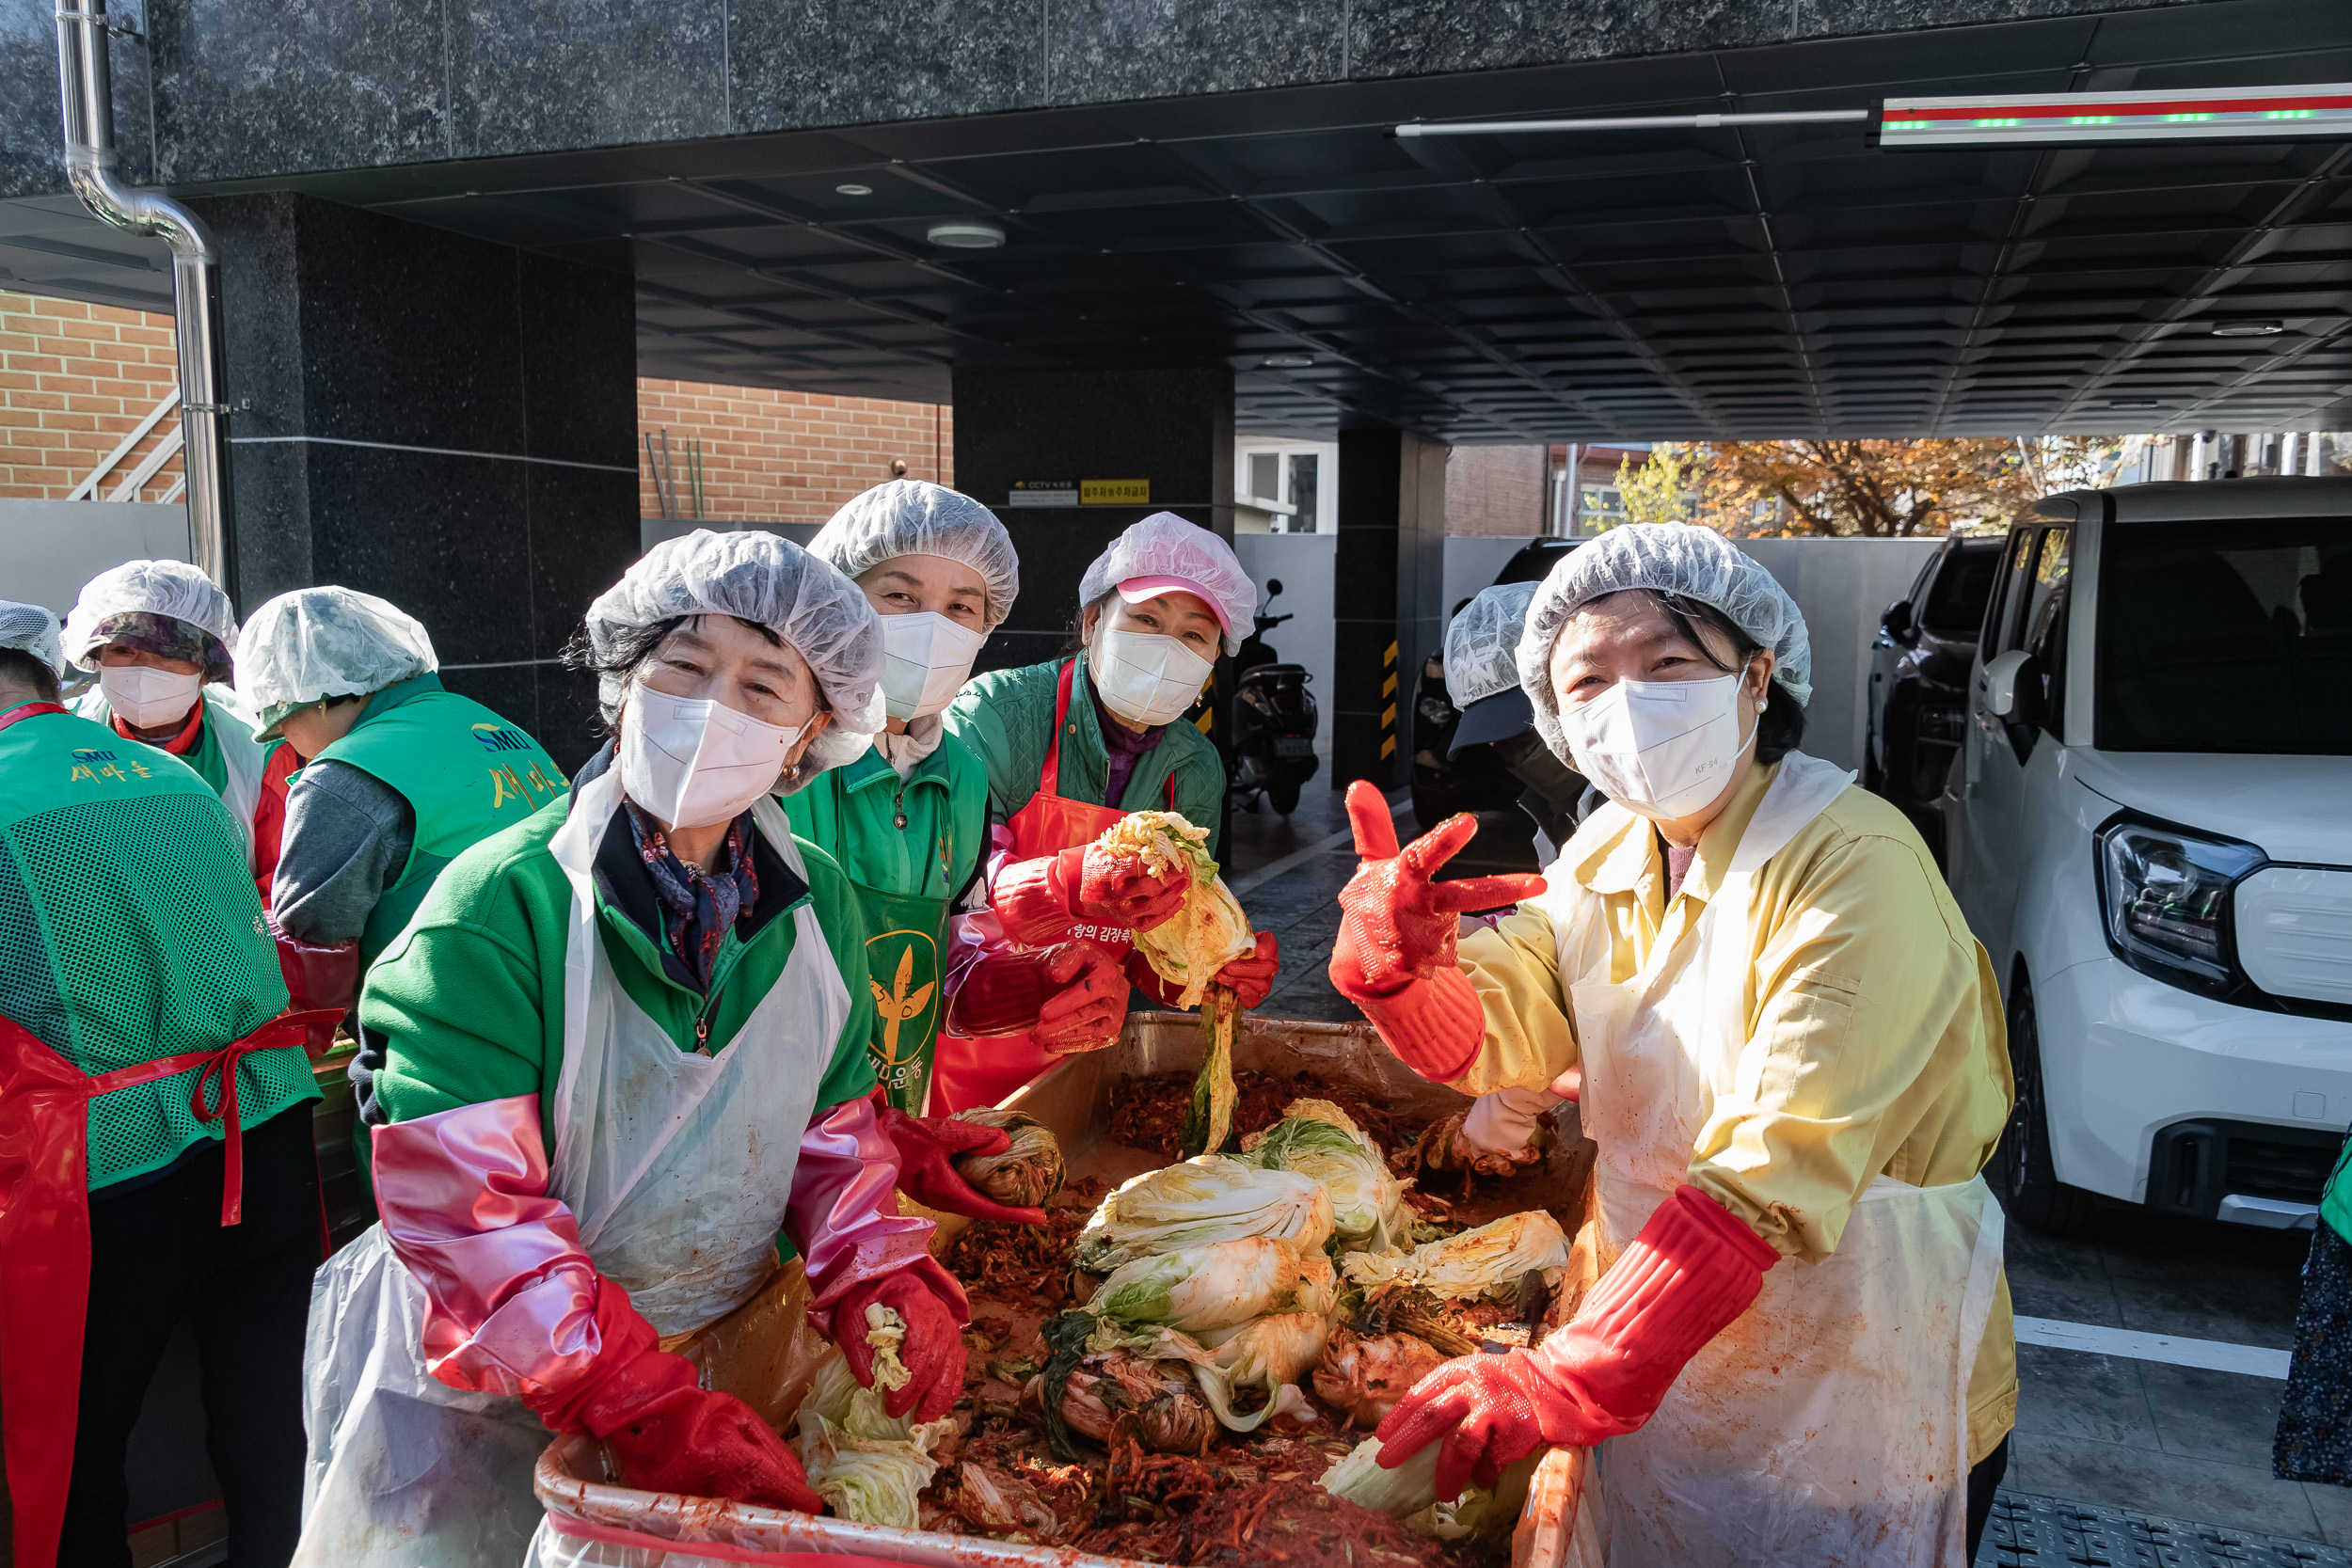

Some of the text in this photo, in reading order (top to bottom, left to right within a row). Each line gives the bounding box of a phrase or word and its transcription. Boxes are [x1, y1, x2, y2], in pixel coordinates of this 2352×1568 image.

[1028, 481, 1051, 489] CCTV
[471, 726, 532, 752] SMU
[72, 749, 118, 763] SMU
[71, 760, 152, 784] 새마을
[1067, 924, 1134, 943] 랑의 김장축
